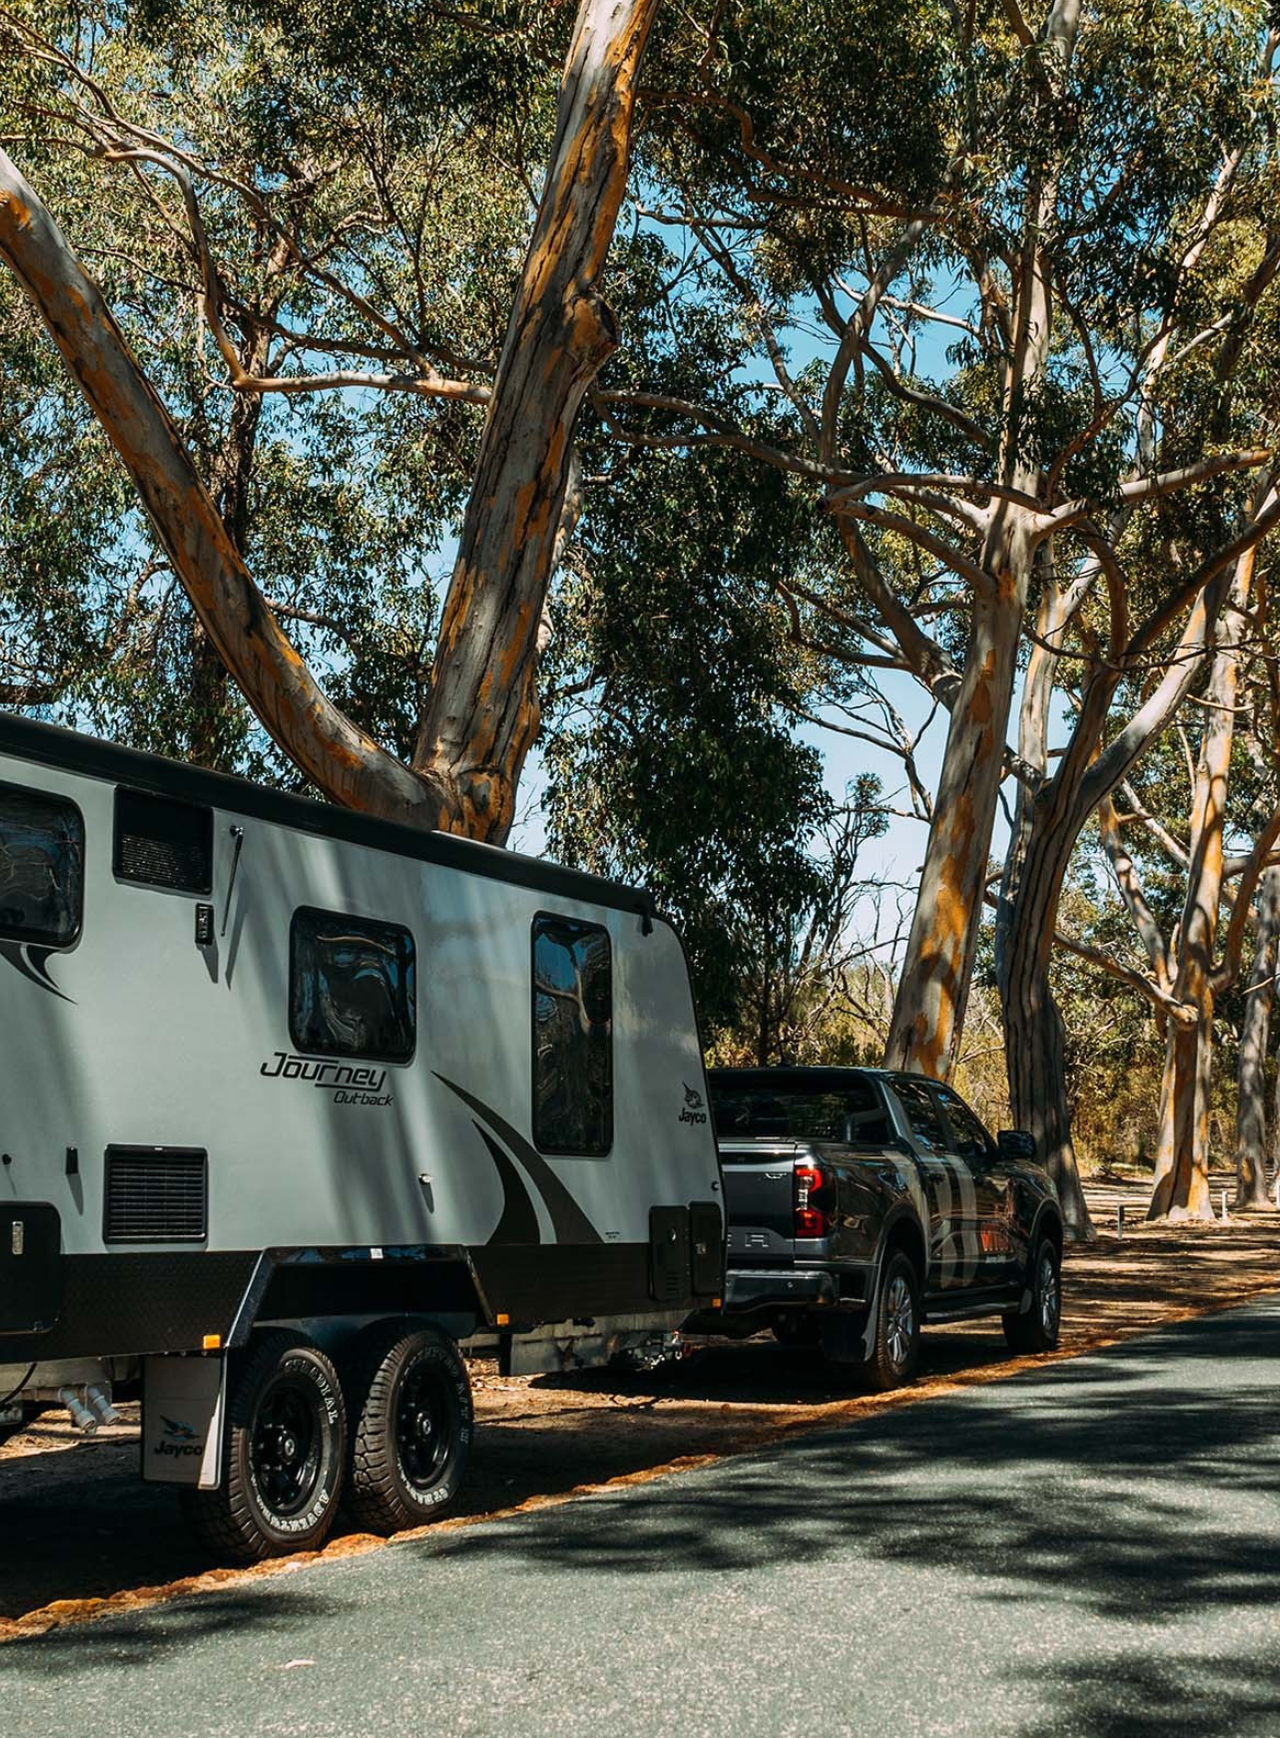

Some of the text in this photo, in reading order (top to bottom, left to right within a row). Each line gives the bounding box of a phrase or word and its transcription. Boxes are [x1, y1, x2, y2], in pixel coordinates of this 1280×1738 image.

[260, 1052, 386, 1092] Journey
[333, 1090, 394, 1107] Outback
[678, 1107, 707, 1127] Jayco
[153, 1441, 203, 1459] Jayco
